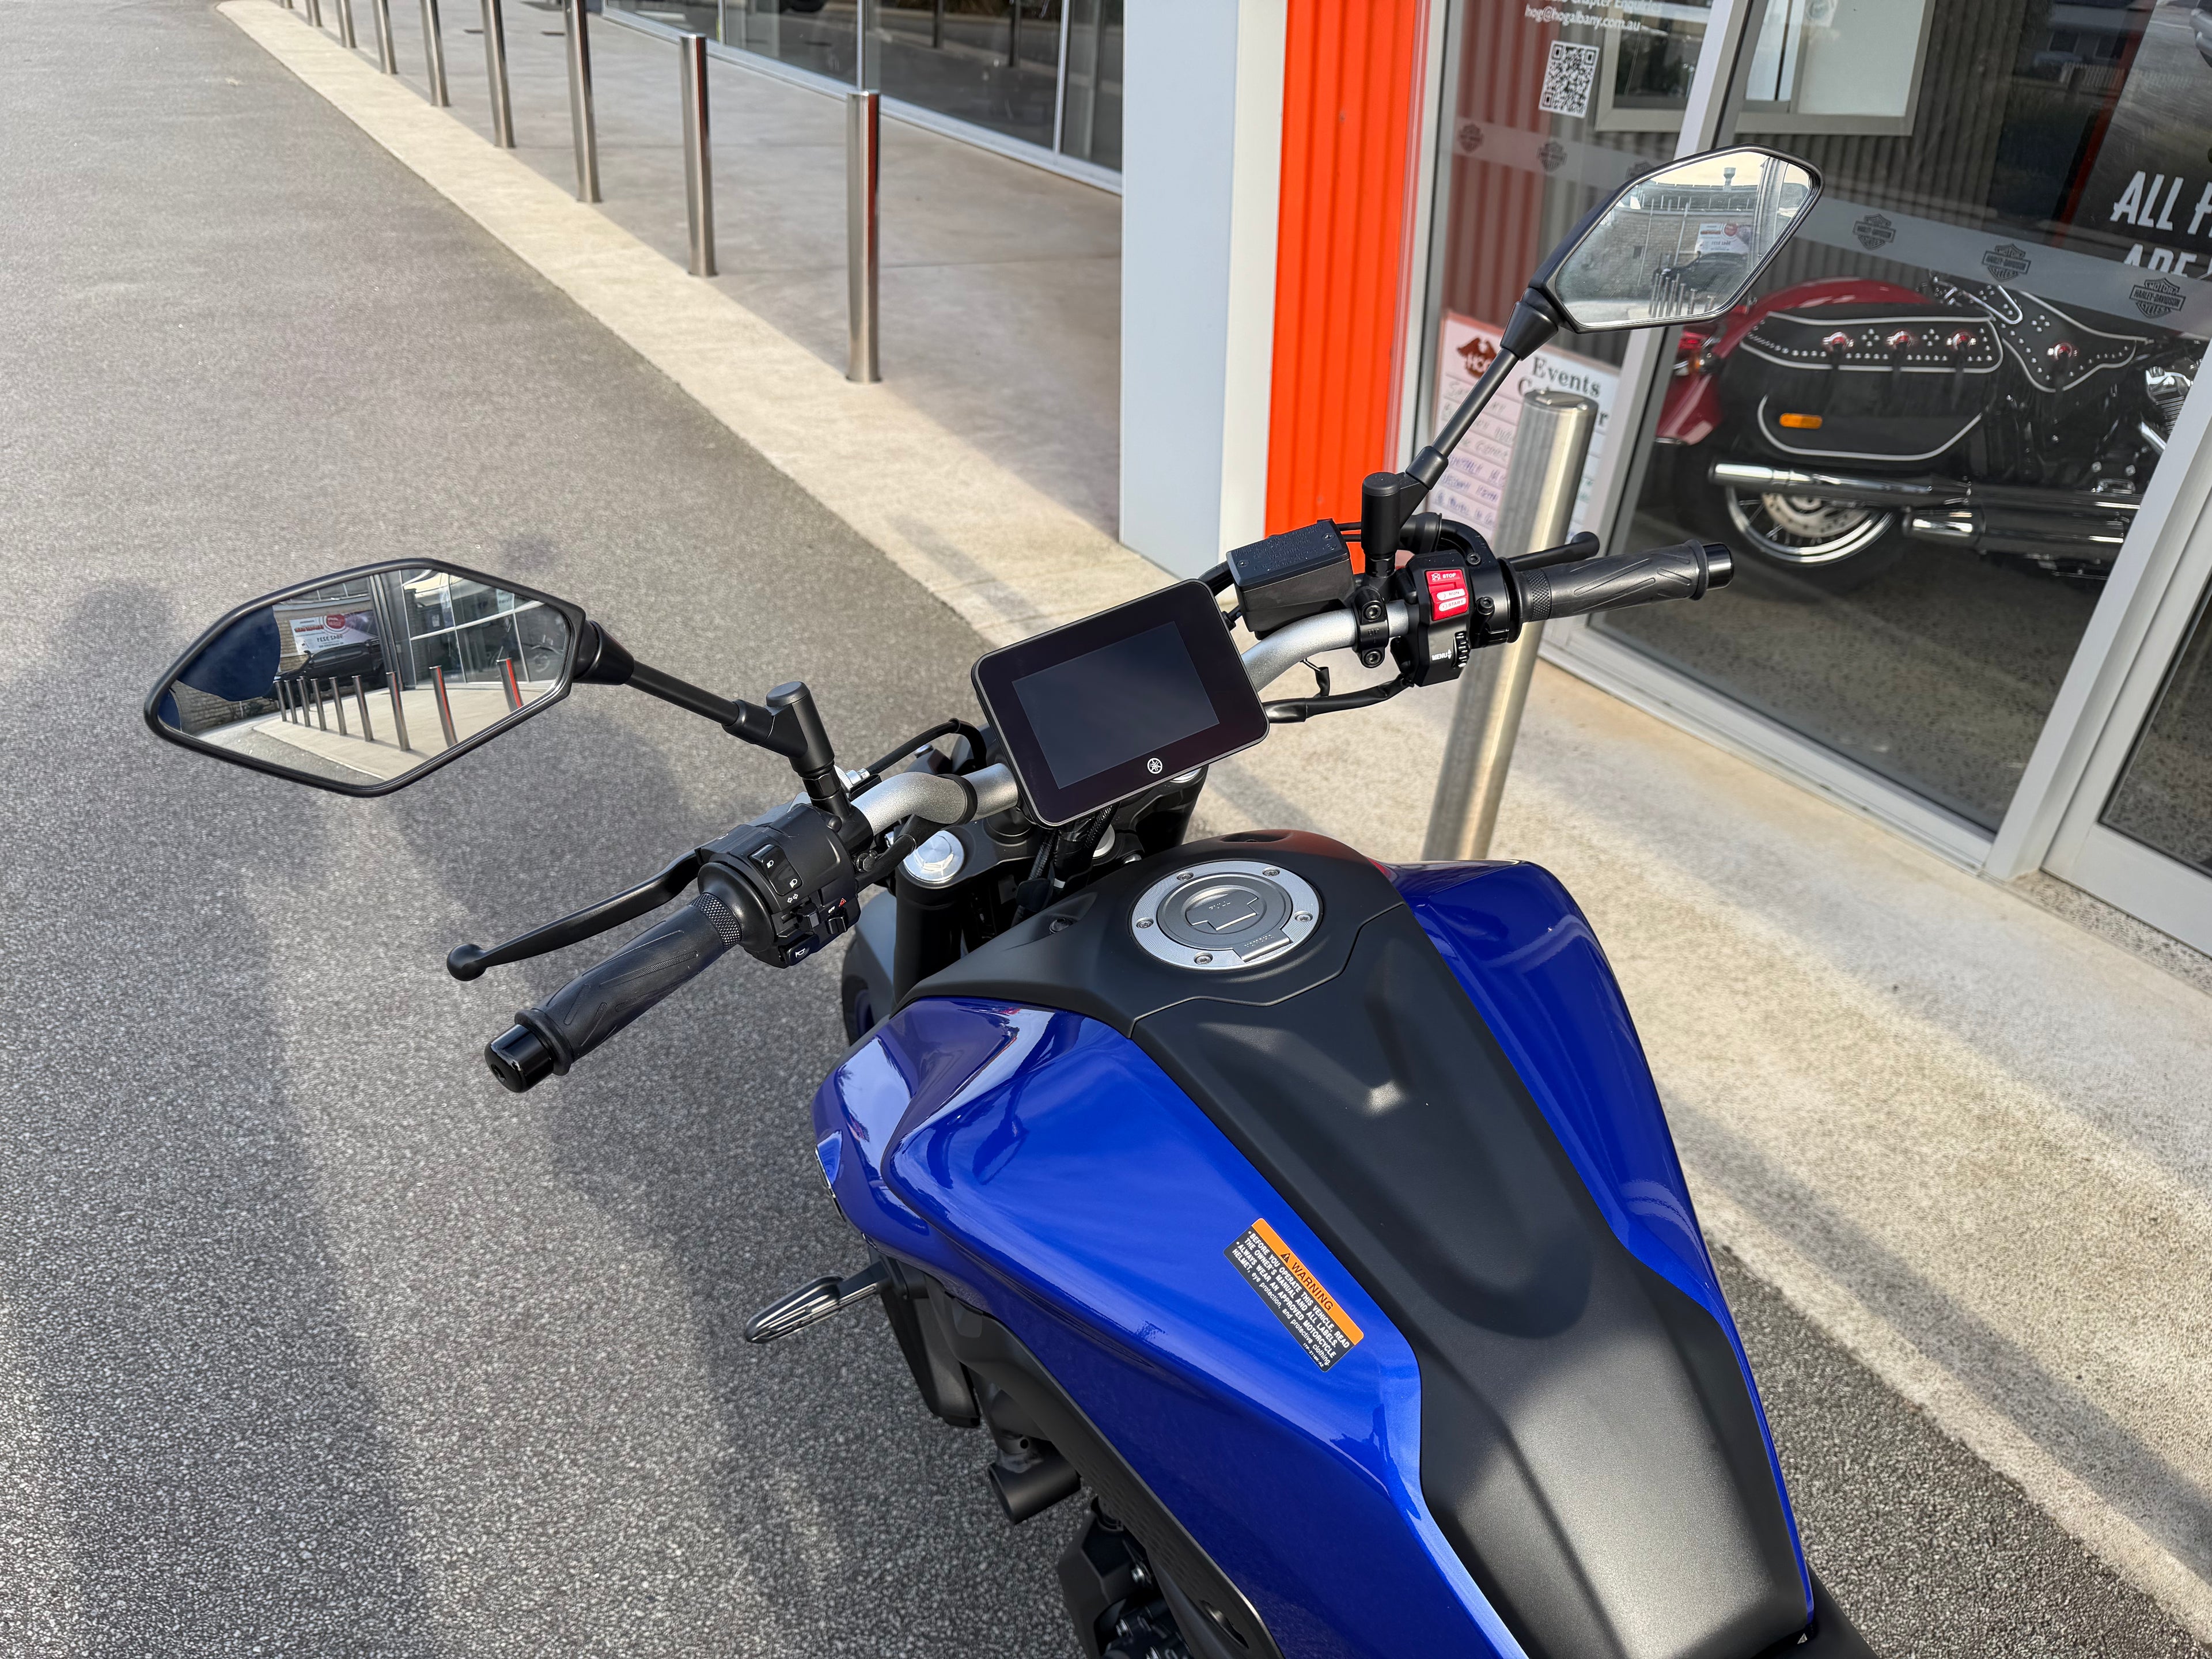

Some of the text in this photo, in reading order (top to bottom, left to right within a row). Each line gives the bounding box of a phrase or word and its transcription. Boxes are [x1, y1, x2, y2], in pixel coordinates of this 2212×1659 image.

[1525, 4, 1641, 31] hog@hogalbany.com.au
[2110, 171, 2184, 230] ALL
[1533, 357, 1600, 398] Events
[1431, 652, 1448, 660] MENU
[1232, 1248, 1331, 1366] HELMET, eye protection, and protective clothing.
[1237, 1244, 1337, 1359] ALWAYS WEAR AN APPROVED MOTORCYCLE
[1244, 1237, 1338, 1348] THE OWNER'S MANUAL AND ALL LABELS.
[1249, 1233, 1350, 1349] BEFORE YOU OPERATE THIS VEHICLE, READ
[1291, 1262, 1333, 1311] WARNING
